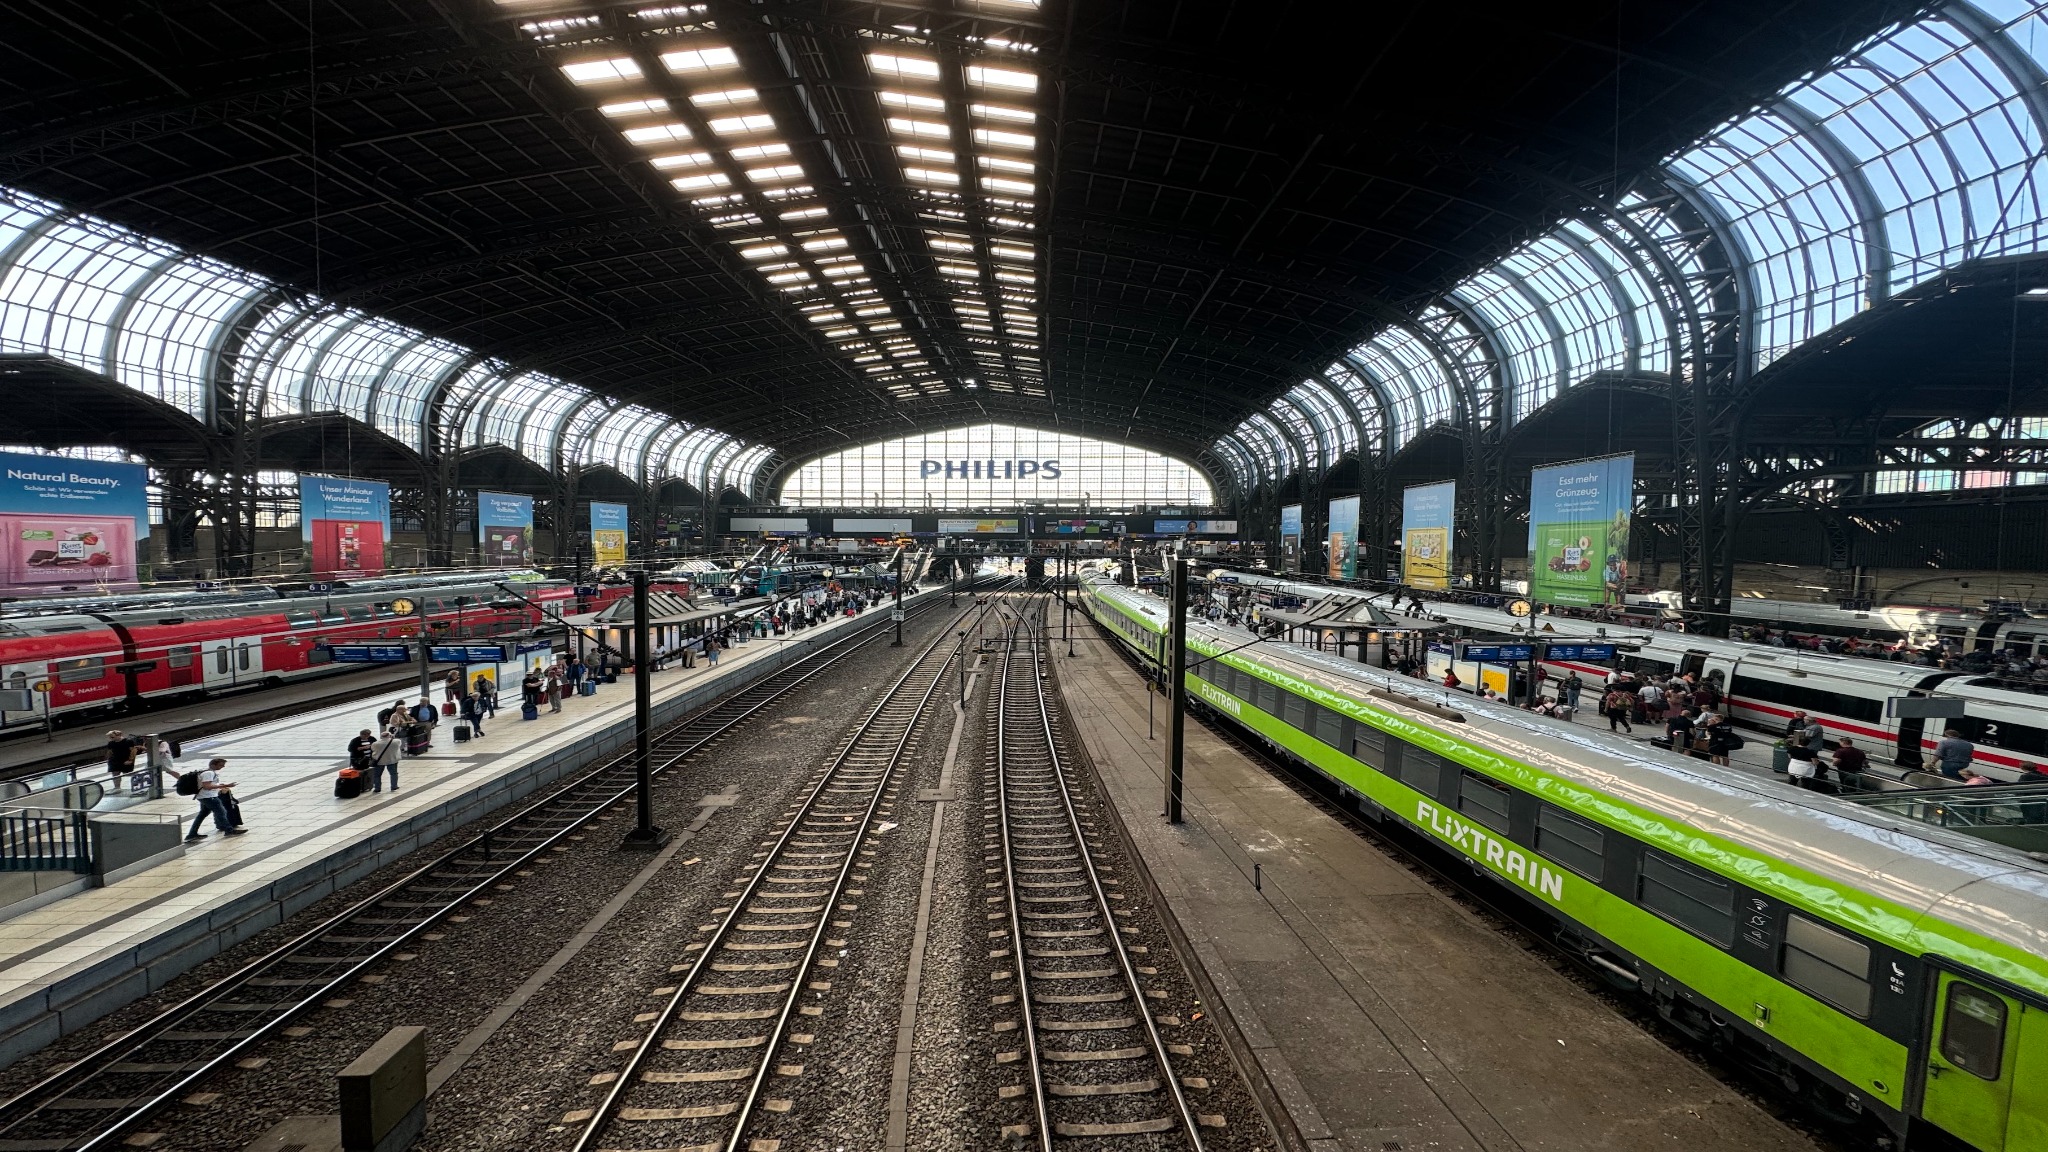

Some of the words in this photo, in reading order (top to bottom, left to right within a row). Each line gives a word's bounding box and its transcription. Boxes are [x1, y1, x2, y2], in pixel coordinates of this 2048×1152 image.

[920, 460, 1062, 480] PHILIPS
[7, 469, 66, 482] Natural
[69, 473, 121, 488] Beauty.
[1559, 477, 1574, 486] Esst
[1575, 473, 1599, 484] mehr
[320, 484, 342, 493] Unser
[343, 486, 374, 495] Miniatur
[1555, 487, 1600, 497] Grünzeug.
[322, 493, 371, 504] Wunderland.
[1620, 654, 1626, 662] 2
[1985, 723, 1999, 736] 2
